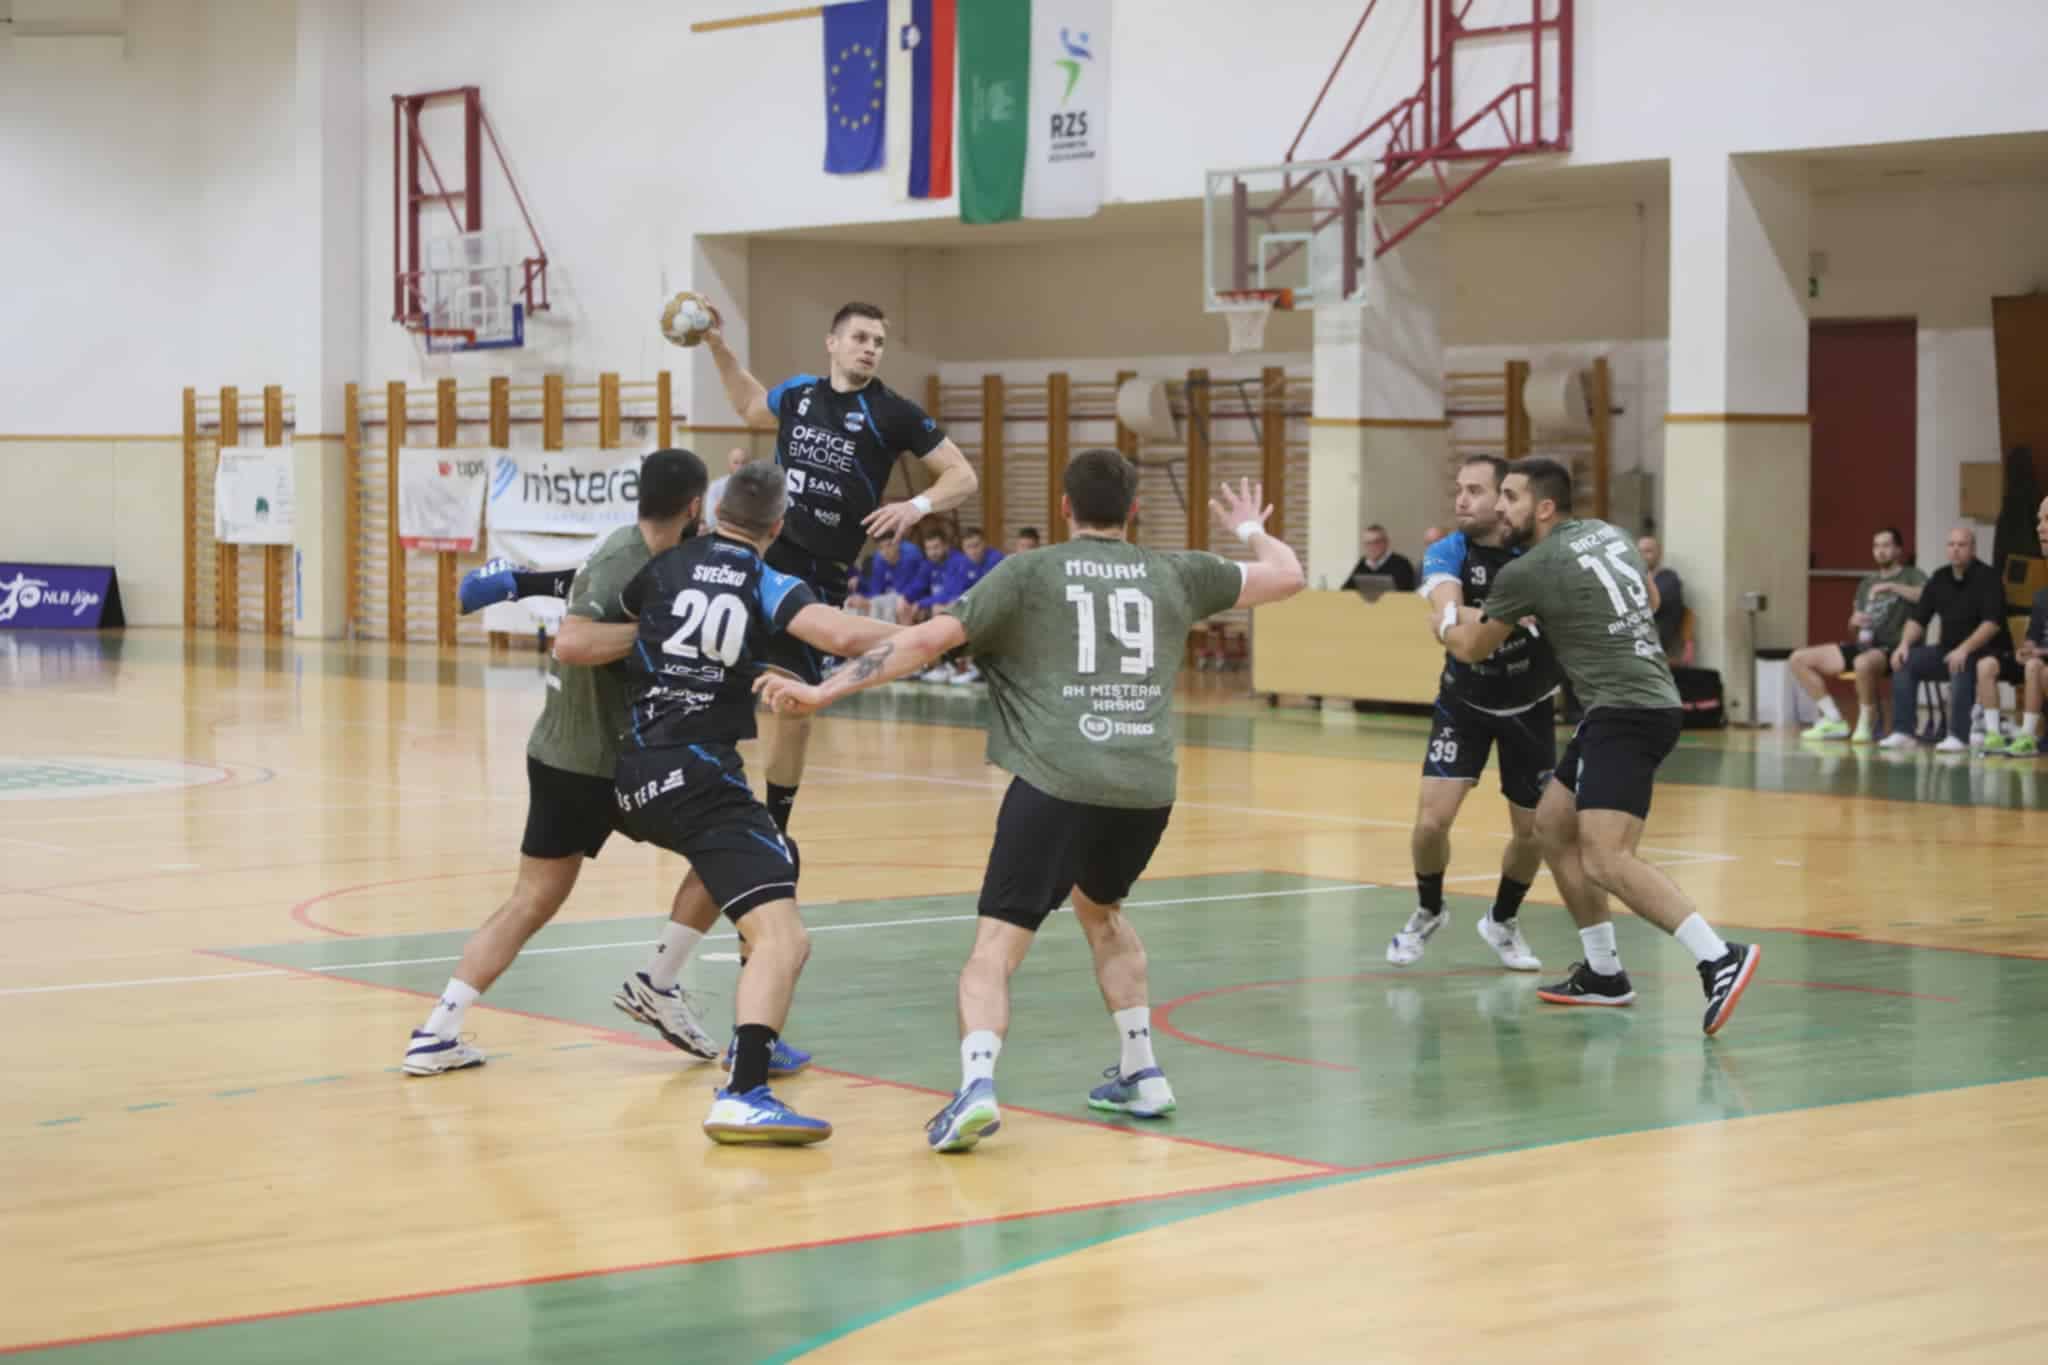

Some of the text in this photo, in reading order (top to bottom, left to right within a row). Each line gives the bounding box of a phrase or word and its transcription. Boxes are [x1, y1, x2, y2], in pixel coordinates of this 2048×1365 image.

[1051, 111, 1088, 139] RZS
[797, 398, 811, 417] 6
[792, 424, 856, 456] OFFICE
[522, 456, 647, 504] mistera
[808, 476, 842, 497] SAVA
[1577, 541, 1649, 617] 15
[661, 588, 748, 667] 20
[1065, 584, 1155, 675] 19
[1429, 739, 1458, 763] 39
